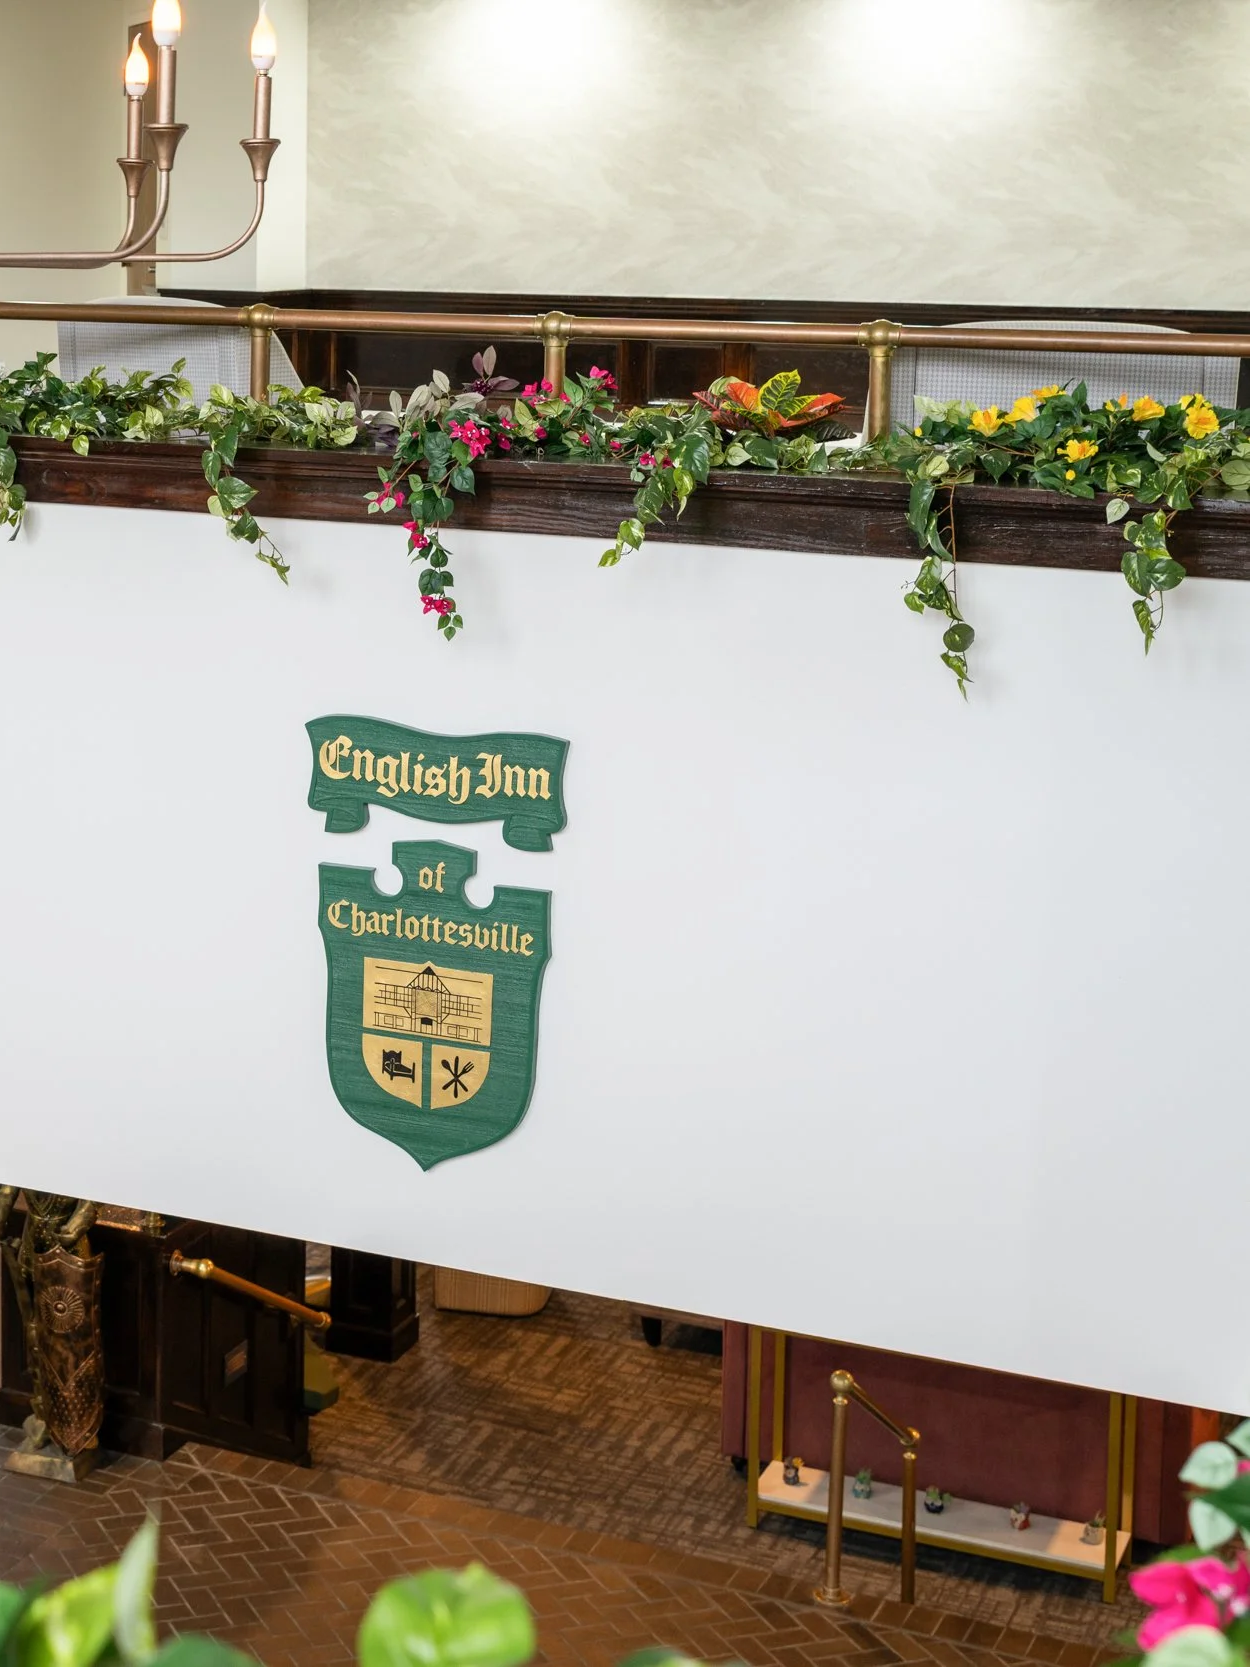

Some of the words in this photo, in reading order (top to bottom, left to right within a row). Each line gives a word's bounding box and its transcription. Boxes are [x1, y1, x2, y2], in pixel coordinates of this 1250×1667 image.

[319, 734, 470, 804] English
[475, 752, 551, 799] Inn
[419, 861, 445, 893] of
[327, 899, 534, 956] Charlottesville
